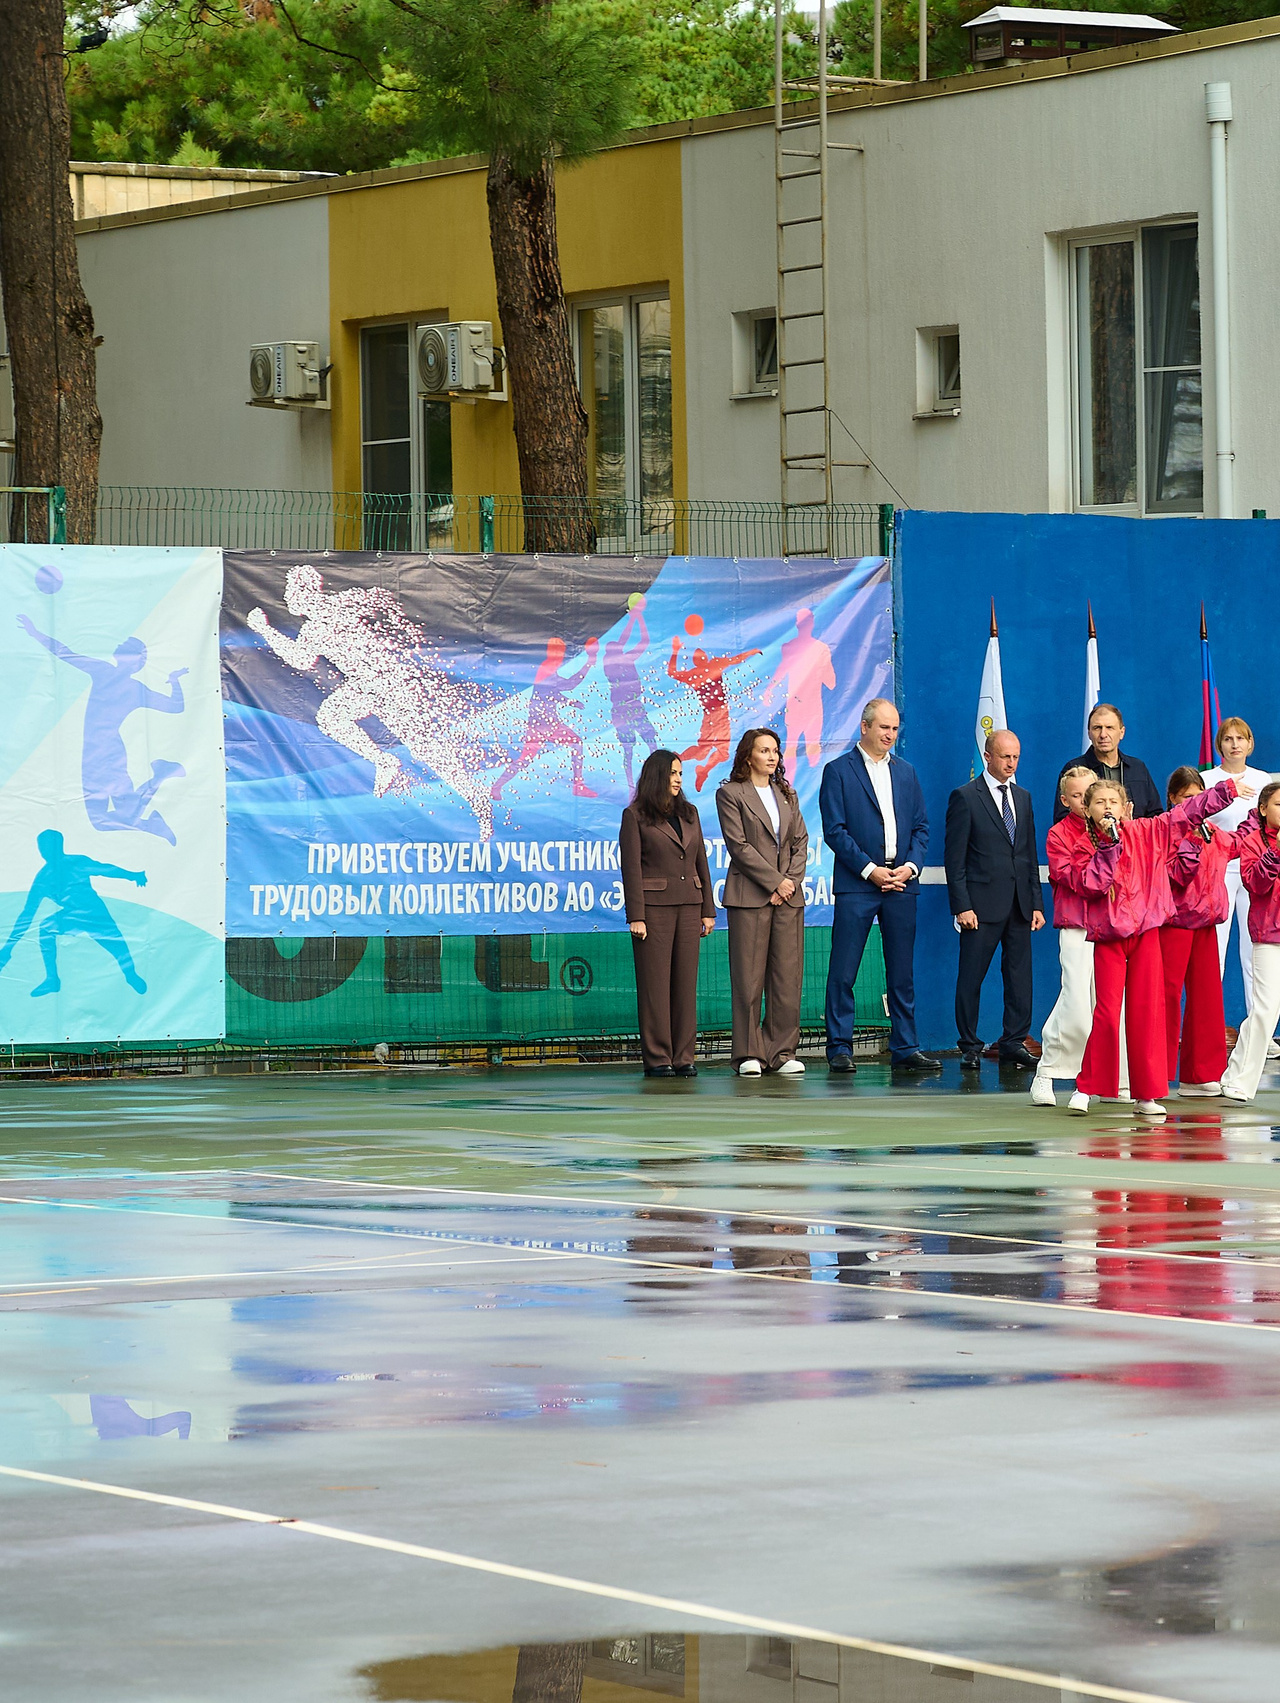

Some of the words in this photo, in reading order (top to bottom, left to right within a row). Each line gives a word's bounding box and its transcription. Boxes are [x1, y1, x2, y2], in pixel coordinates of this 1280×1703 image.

[307, 841, 492, 874] ПРИВЕТСТВУЕМ
[496, 840, 622, 872] УЧАСТНИК
[249, 884, 384, 922] ТРУДОВЫХ
[388, 882, 559, 915] КОЛЛЕКТИВОВ
[563, 881, 595, 912] АО
